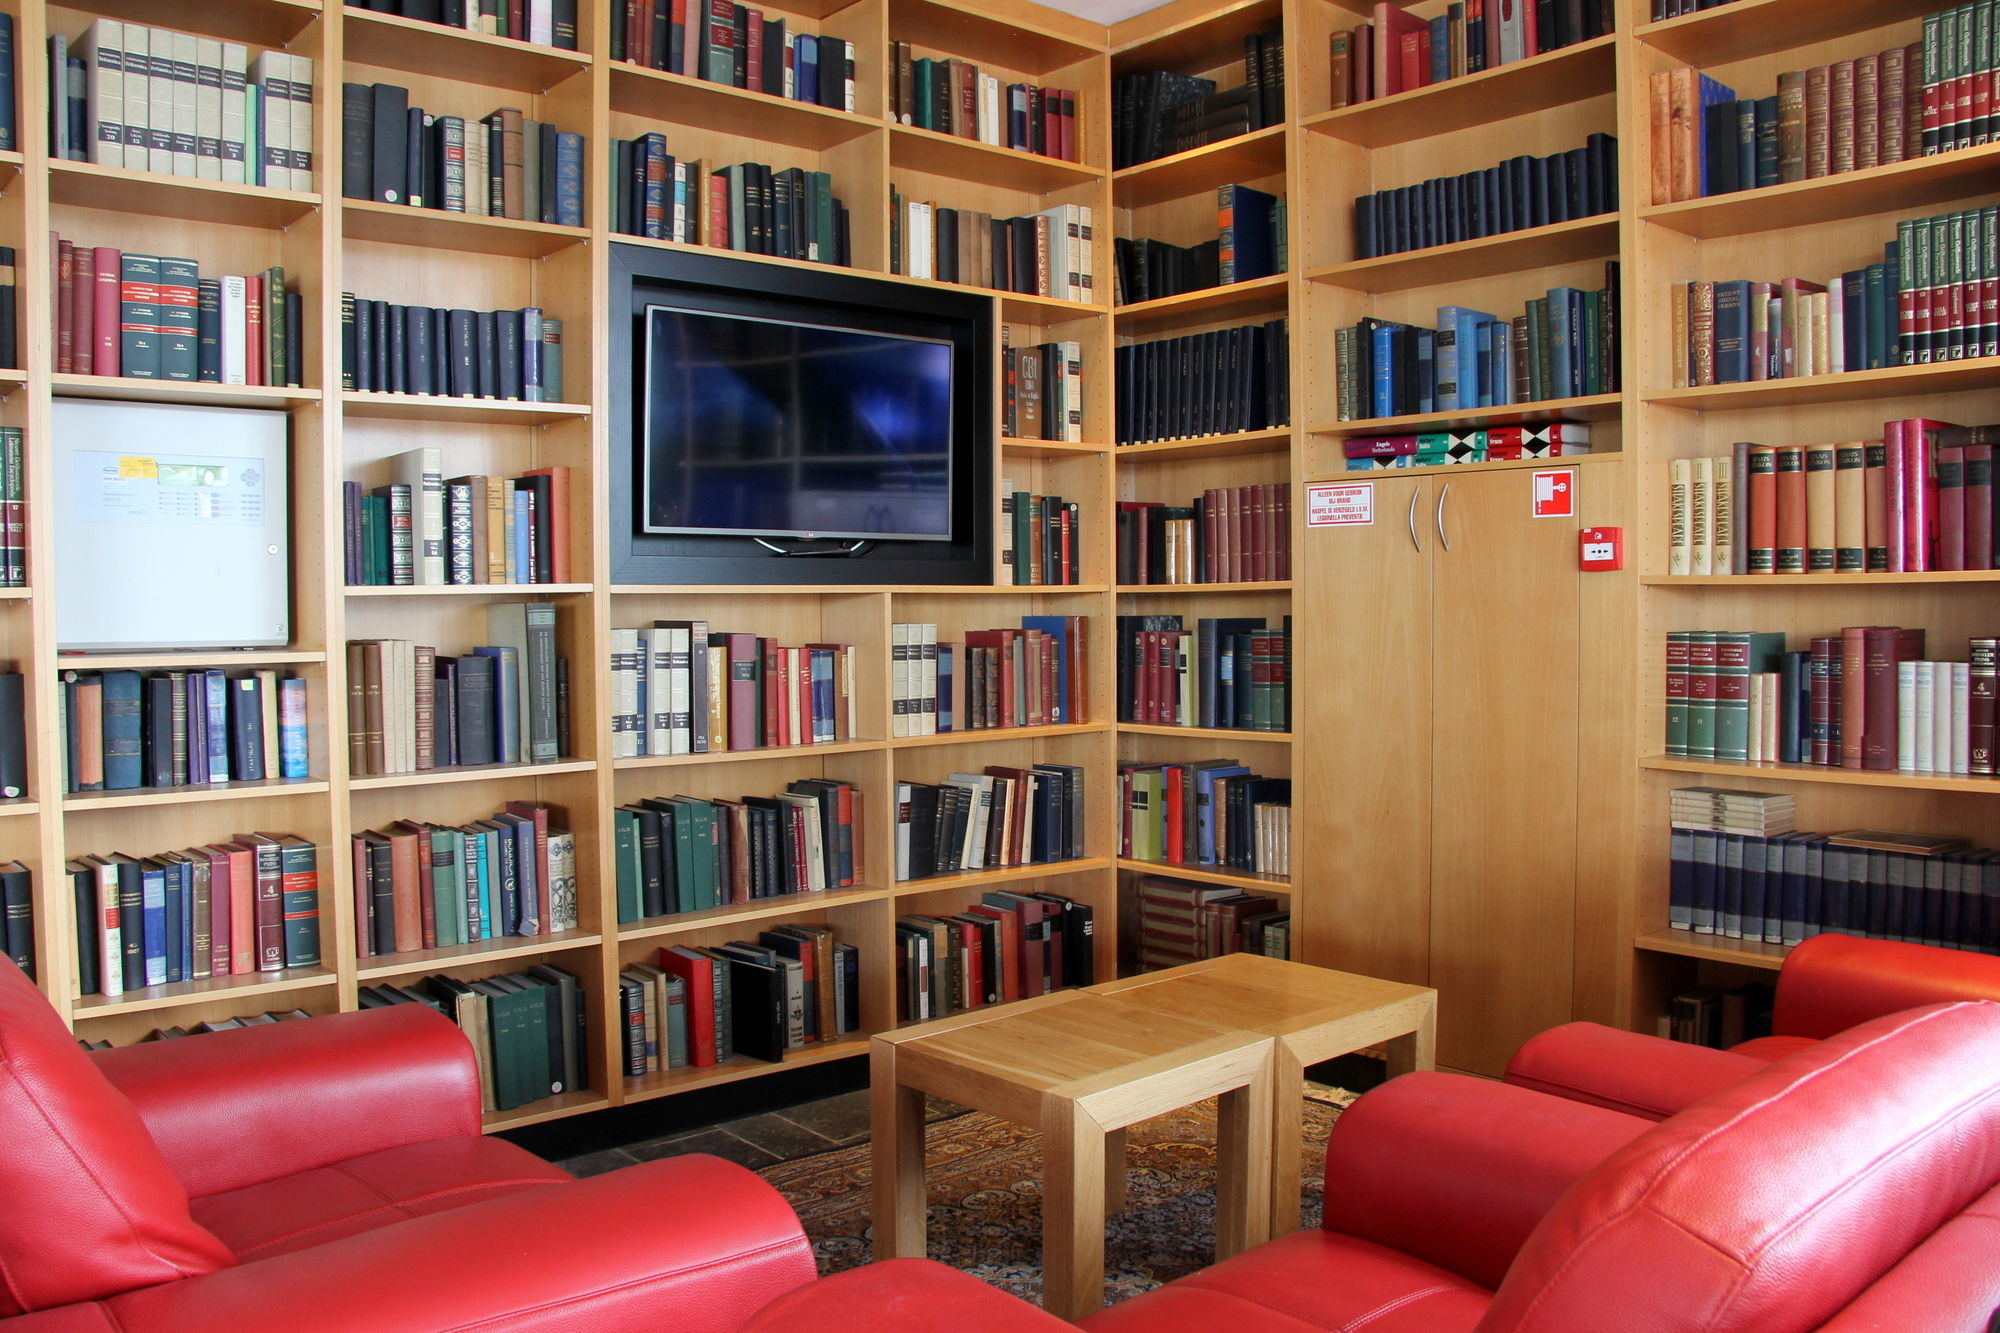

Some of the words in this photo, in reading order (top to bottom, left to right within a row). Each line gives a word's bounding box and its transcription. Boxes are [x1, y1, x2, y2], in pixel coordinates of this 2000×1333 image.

[1717, 289, 1741, 297] RECENT
[1023, 356, 1037, 379] CBI
[1672, 484, 1684, 546] SHAKESPEARE
[1694, 483, 1705, 545] SHAKESPEARE
[1716, 483, 1729, 545] SHAKESPEARE
[1978, 682, 1985, 692] 4
[267, 885, 274, 894] 4
